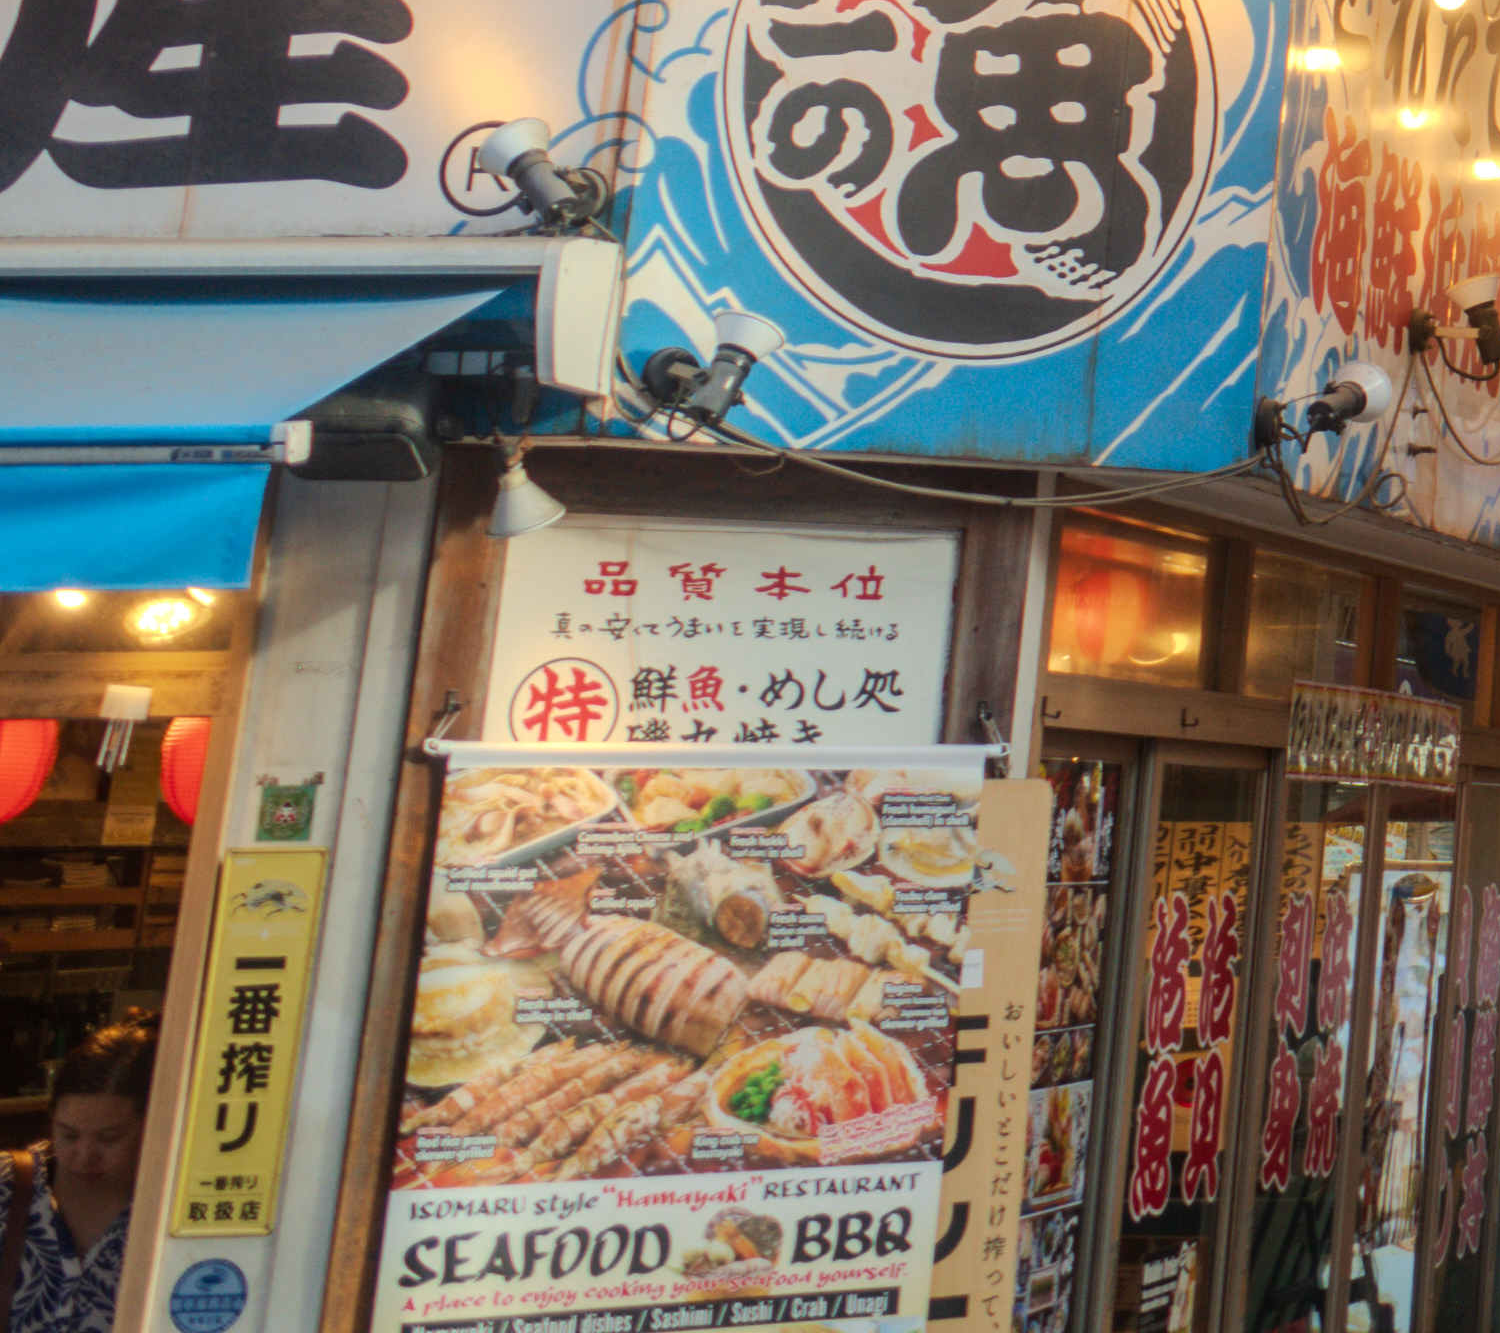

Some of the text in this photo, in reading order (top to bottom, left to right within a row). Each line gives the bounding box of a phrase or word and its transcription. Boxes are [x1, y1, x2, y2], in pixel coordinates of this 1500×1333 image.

[584, 561, 887, 602] 品質本位
[550, 611, 900, 642] 真の安くてうまいを実現し続ける
[629, 663, 905, 715] 鮮魚・めし処
[522, 666, 609, 741] 特
[635, 830, 669, 843] Cheese
[671, 829, 693, 841] and
[448, 867, 487, 880] Grilled
[488, 866, 516, 882] squid
[448, 879, 468, 891] and
[590, 896, 656, 911] Grilled squid
[516, 1007, 592, 1024] scallop in shell
[518, 996, 580, 1011] Fresh whole
[213, 954, 289, 1154] 一番搾り
[416, 1136, 439, 1149] Red
[463, 1134, 498, 1150] prawn
[200, 1175, 259, 1192] 一番搾り
[410, 1194, 528, 1221] ISOMARU
[534, 1191, 600, 1221] style
[763, 1172, 923, 1201] RESTAURANT
[188, 1200, 262, 1221] 取扱店
[398, 1206, 914, 1288] SEAFOOD BBQ
[402, 1262, 910, 1317] A place to enjoy cooking your seafood yourself.
[580, 1308, 634, 1333] dishes
[651, 1303, 715, 1329] Sashimi
[729, 1298, 774, 1324] Sushi
[790, 1292, 829, 1320] Crab
[845, 1289, 890, 1319] Unagi
